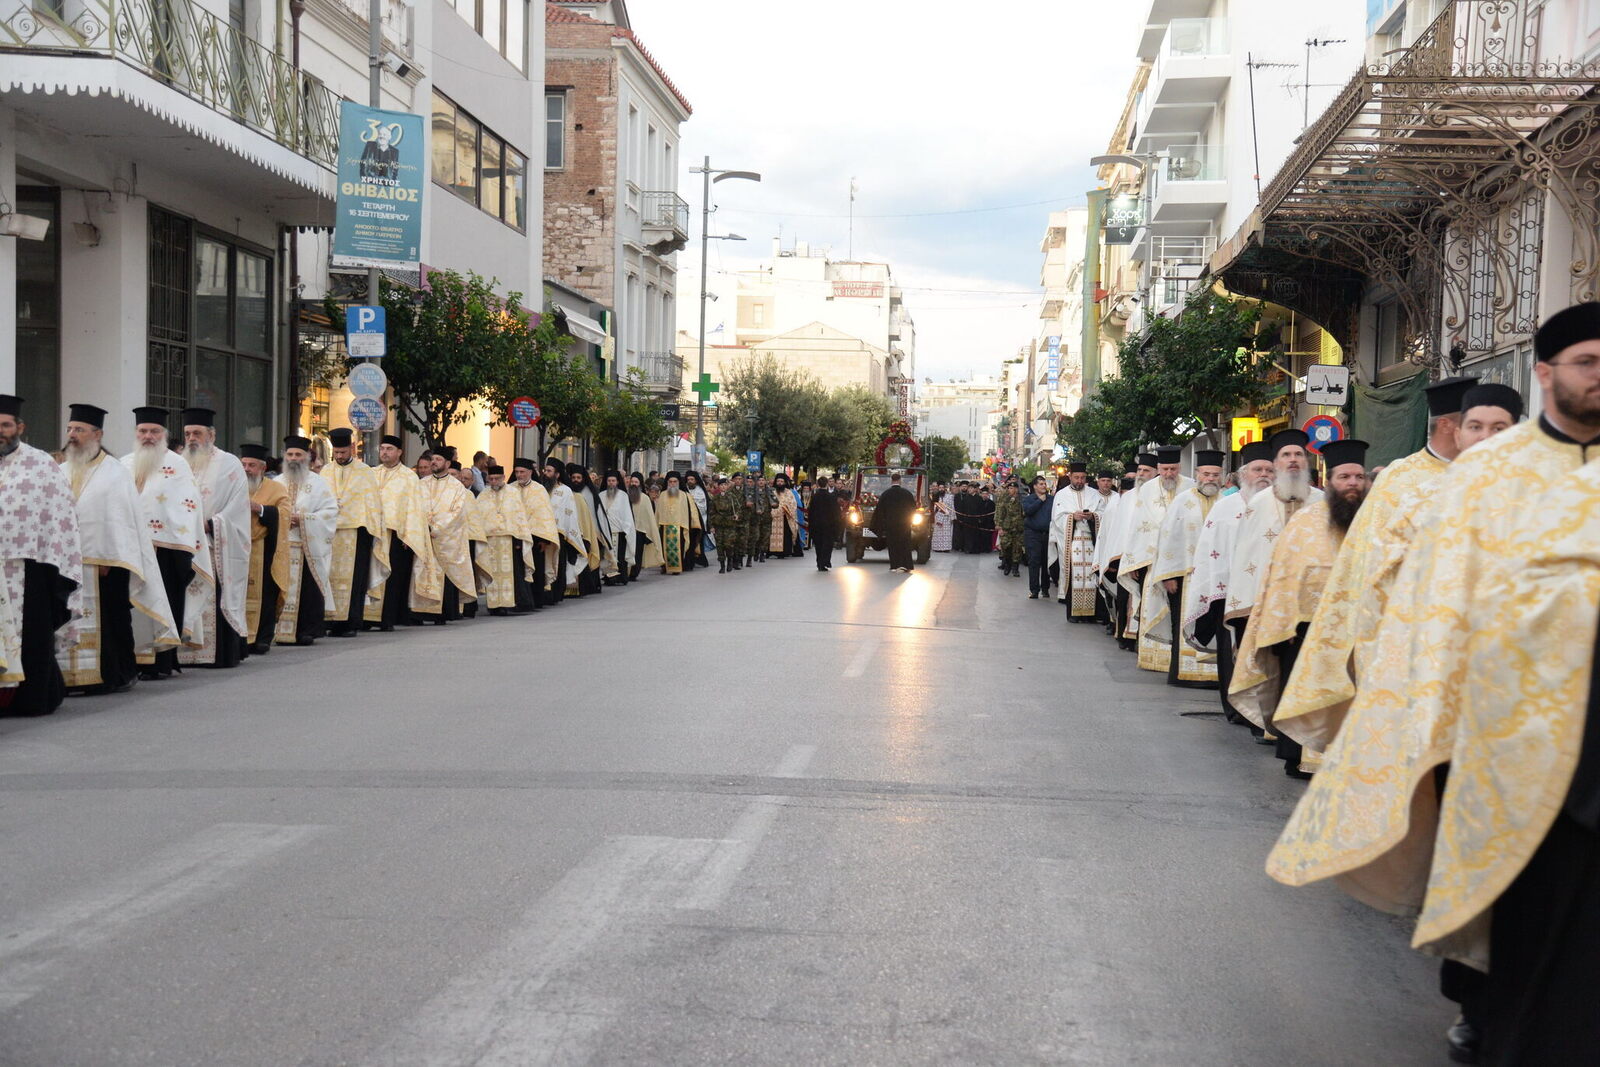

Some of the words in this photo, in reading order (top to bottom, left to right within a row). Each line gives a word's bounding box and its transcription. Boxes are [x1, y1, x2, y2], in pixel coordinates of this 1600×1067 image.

[360, 176, 401, 187] ΧΡΗΣΤΟΣ
[341, 182, 418, 203] ΘΗΒΑΙΟΣ
[362, 201, 396, 212] ΤΕΤΑΡΤΗ
[348, 209, 356, 217] 16
[357, 210, 410, 222] ΣΕΠΤΕΜΒΡΙΟΥ
[359, 308, 375, 330] P
[750, 453, 758, 462] P
